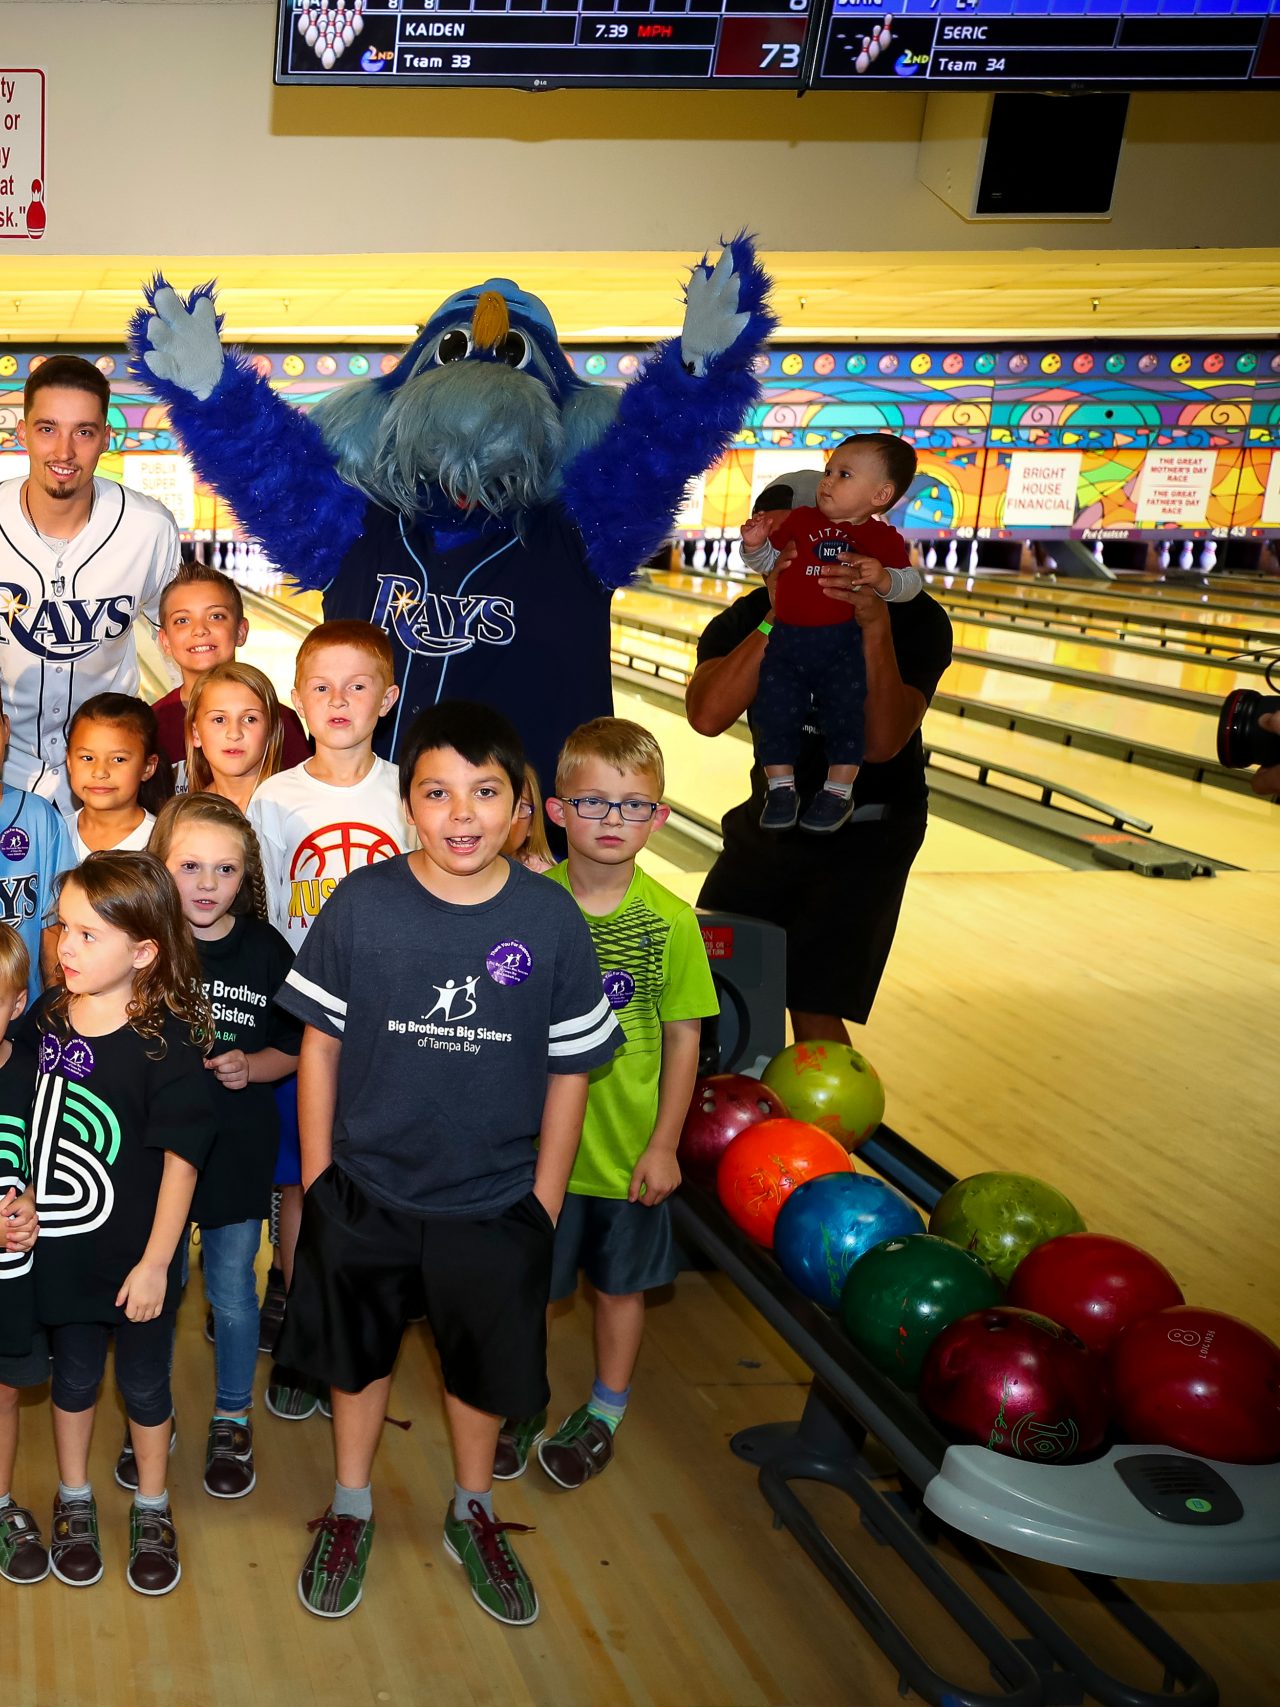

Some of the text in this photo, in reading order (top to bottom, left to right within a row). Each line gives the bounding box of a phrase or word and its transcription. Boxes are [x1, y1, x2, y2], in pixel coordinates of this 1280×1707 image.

[405, 23, 465, 36] KAIDEN
[595, 24, 673, 38] 7.39 MPH
[404, 55, 470, 68] Team 33
[759, 44, 801, 68] 73
[939, 58, 1005, 72] Team 34
[4, 114, 20, 130] or
[1023, 468, 1066, 480] BRIGHT
[1022, 484, 1061, 495] HOUSE
[1007, 499, 1072, 511] FINANCIAL
[977, 527, 991, 538] 41
[370, 574, 516, 657] RAYS
[213, 980, 268, 1007] Brothers
[211, 1003, 256, 1027] Sisters.
[223, 1031, 237, 1041] BAY
[388, 1020, 512, 1042] Big Brothers Big Sisters
[417, 1037, 481, 1055] of Tampa Bay
